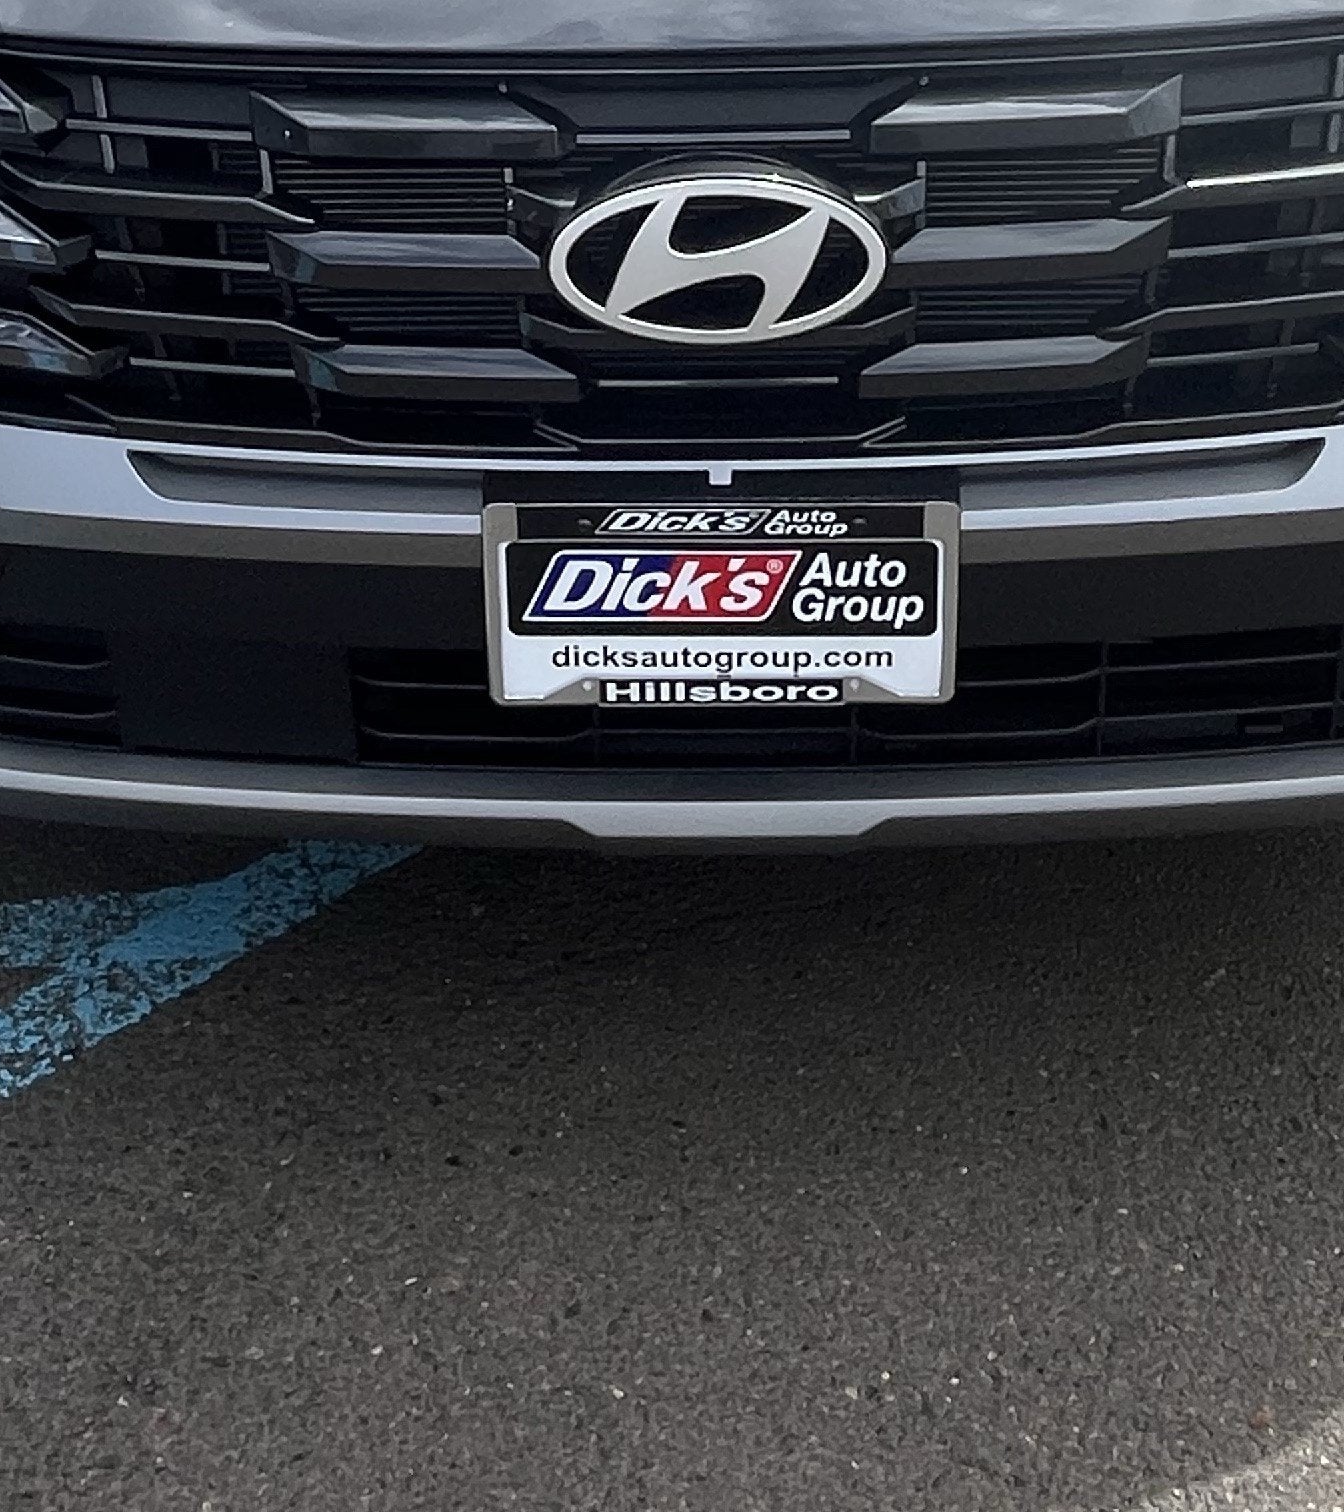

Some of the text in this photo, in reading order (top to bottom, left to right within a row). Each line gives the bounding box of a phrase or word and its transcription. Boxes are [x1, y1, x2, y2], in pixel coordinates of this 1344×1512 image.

[771, 509, 837, 523] Auto
[764, 522, 848, 538] Group
[799, 551, 907, 588] Auto
[791, 586, 925, 630] Group
[551, 645, 895, 677] dicksautogroup.com
[605, 681, 839, 702] Hillsboro
